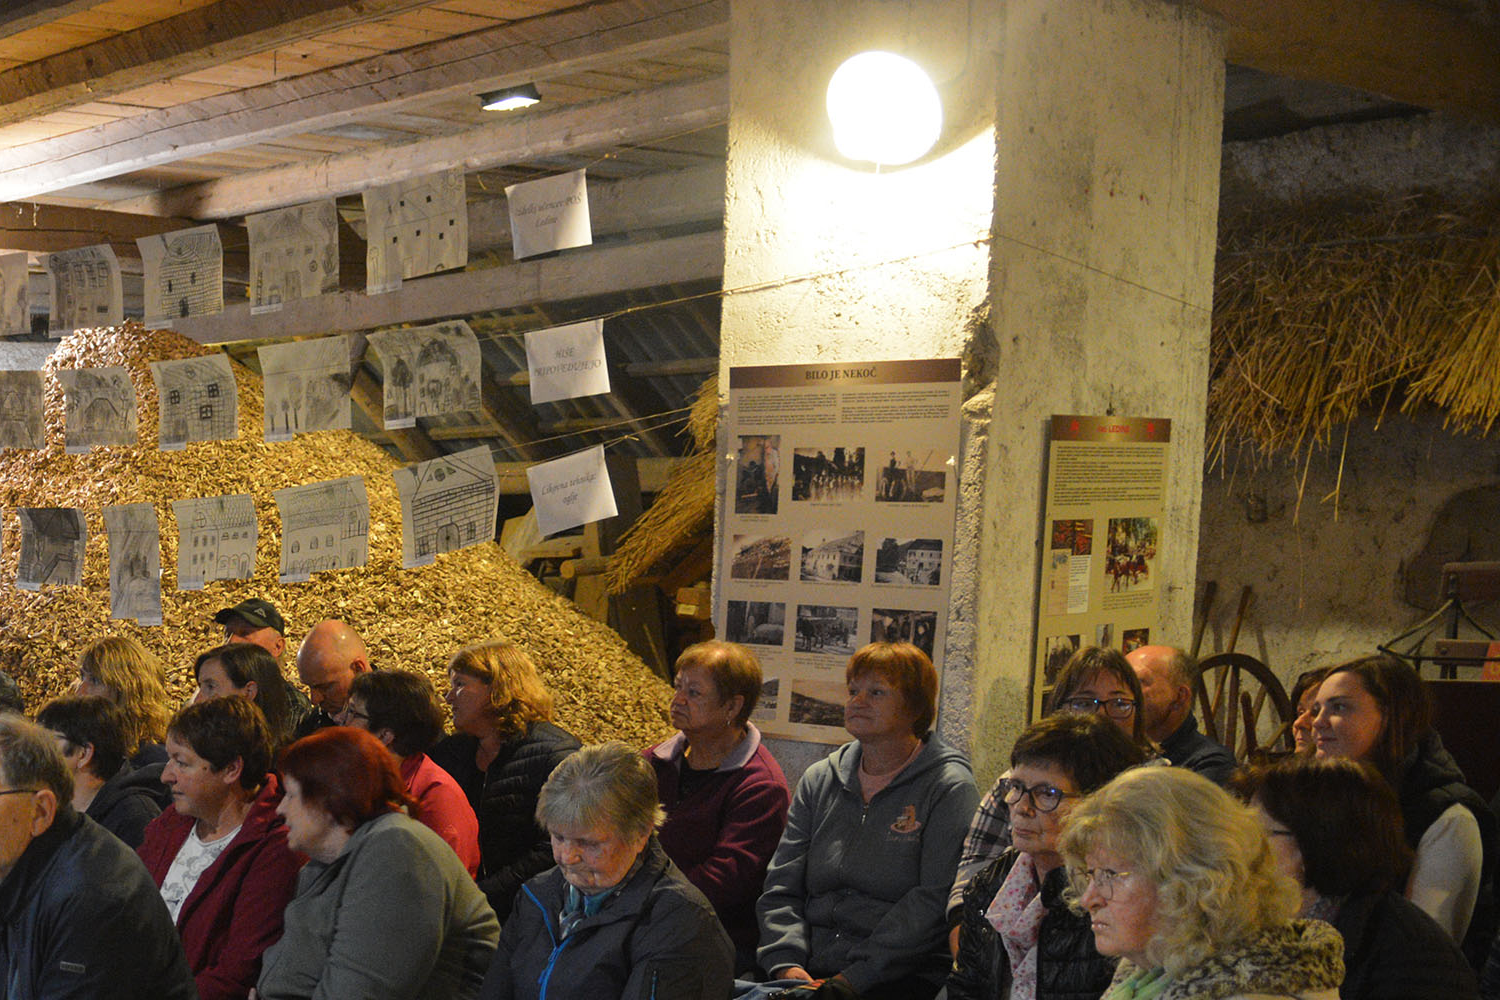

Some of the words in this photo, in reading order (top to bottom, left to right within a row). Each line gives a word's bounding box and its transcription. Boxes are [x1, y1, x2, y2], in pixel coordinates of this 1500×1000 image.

[805, 370, 828, 380] BILO
[829, 369, 840, 381] JE
[843, 366, 877, 379] NEKOČ
